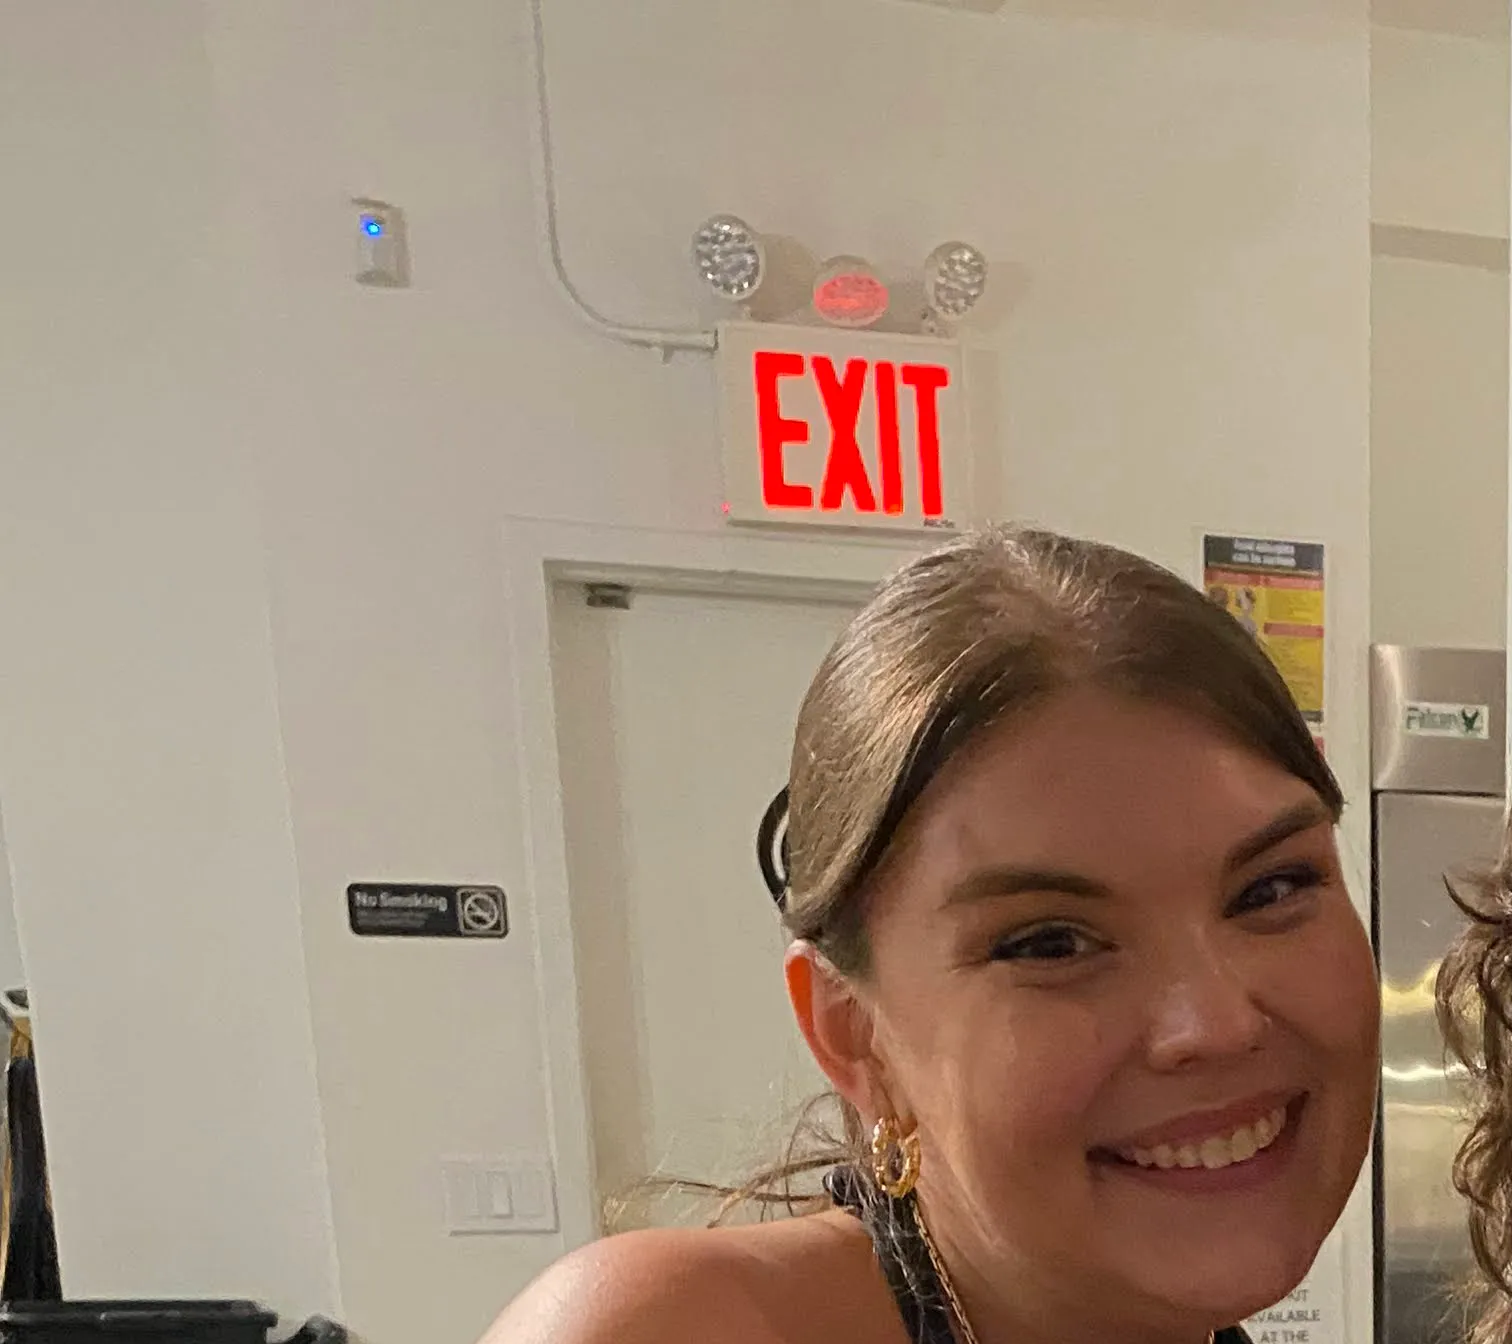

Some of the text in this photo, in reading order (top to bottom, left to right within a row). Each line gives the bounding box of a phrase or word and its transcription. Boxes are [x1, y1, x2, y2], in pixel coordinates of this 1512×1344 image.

[754, 350, 950, 517] EXIT
[354, 891, 448, 912] No Smoking
[1260, 1330, 1310, 1343] AT THE
